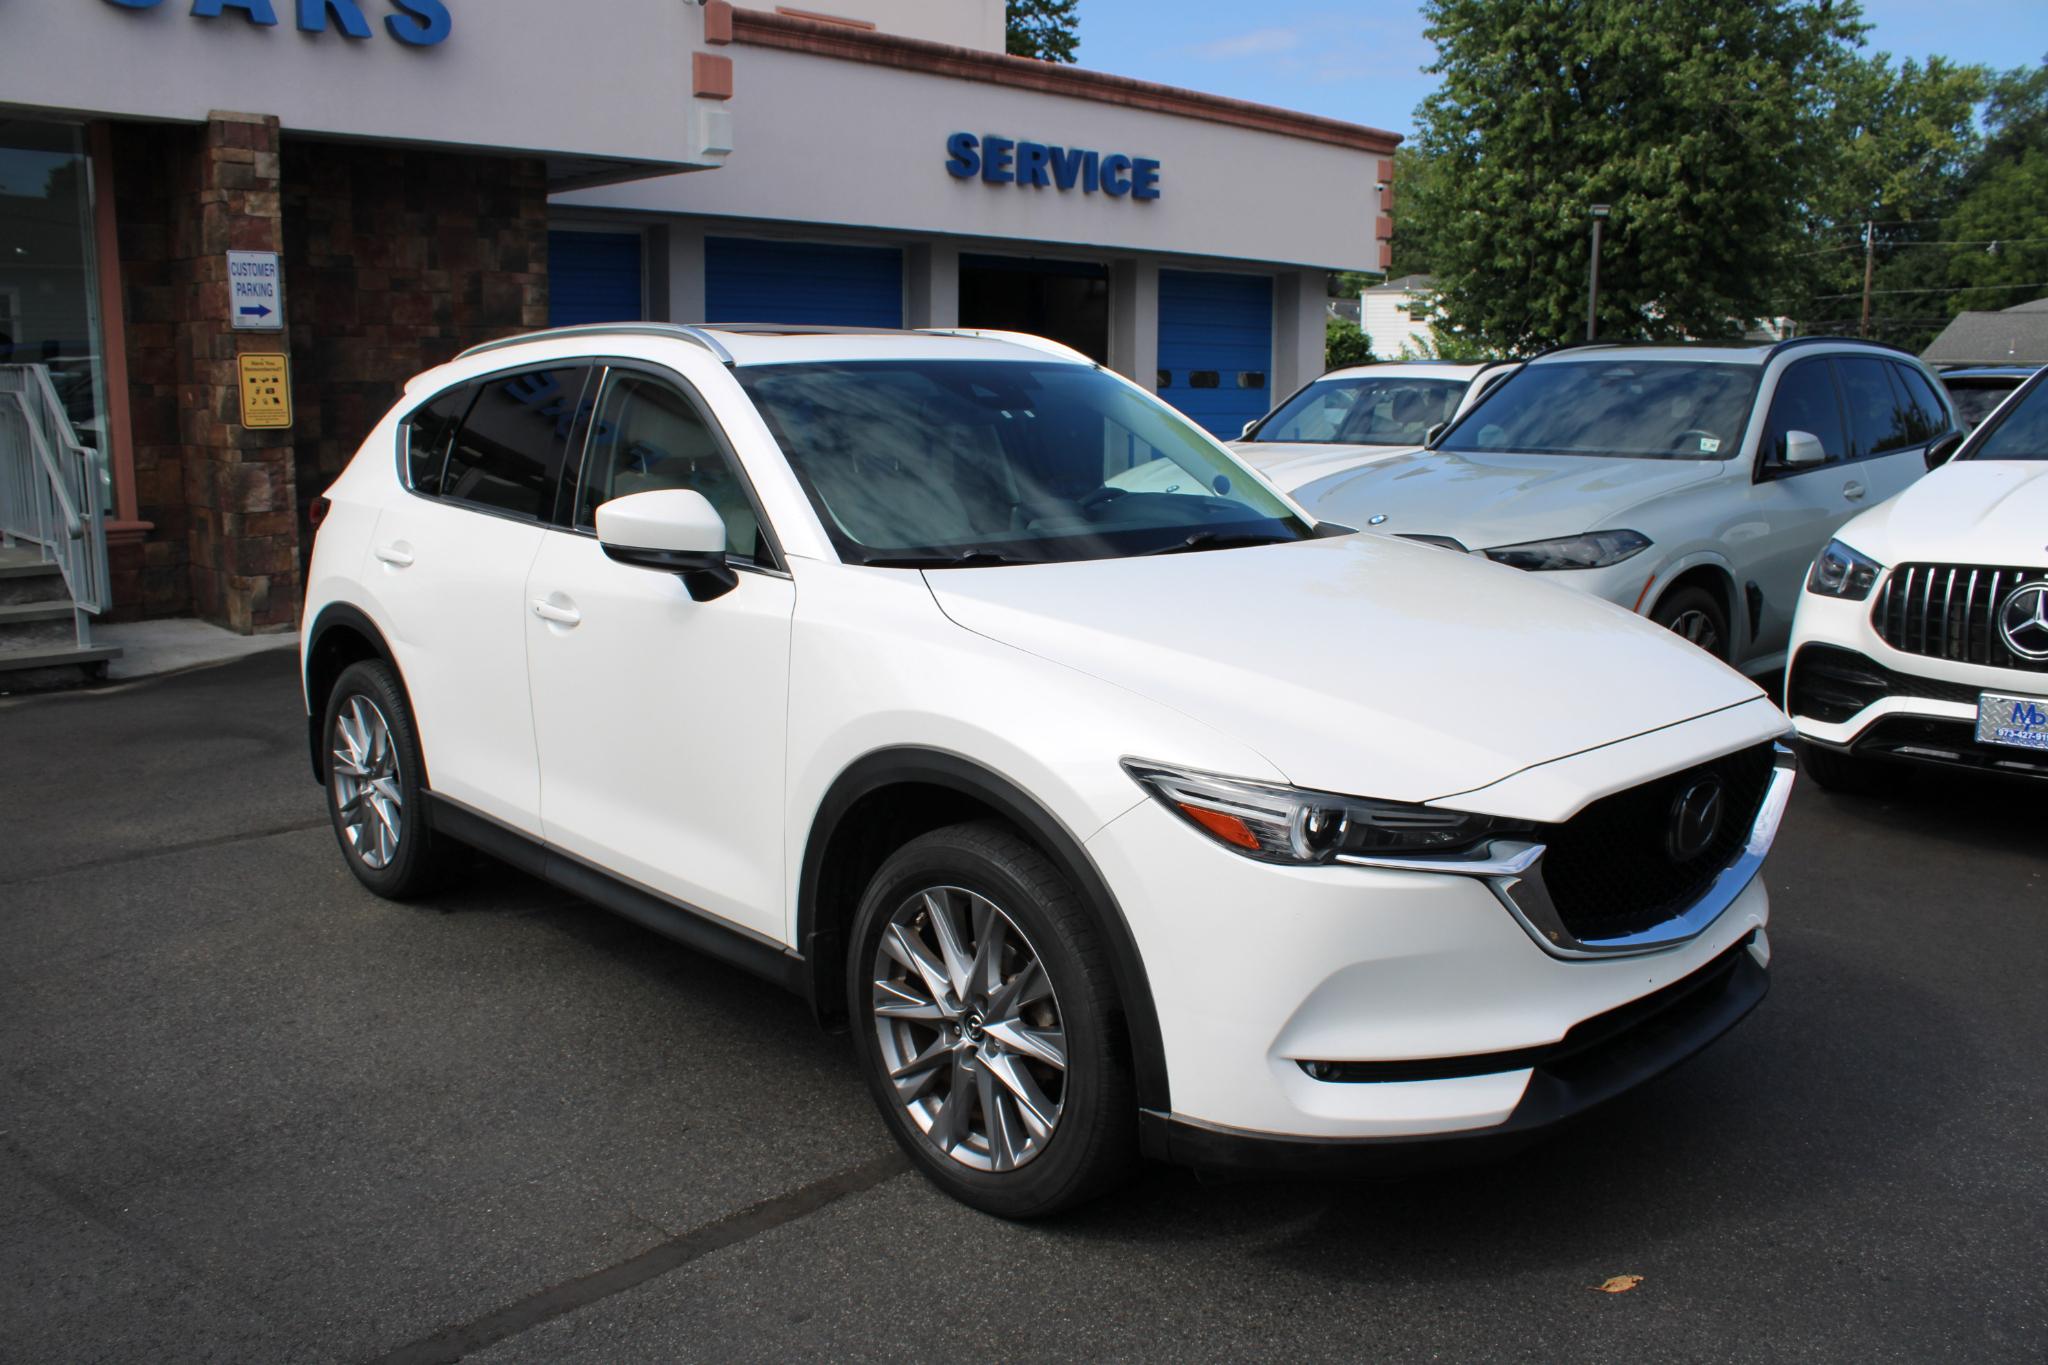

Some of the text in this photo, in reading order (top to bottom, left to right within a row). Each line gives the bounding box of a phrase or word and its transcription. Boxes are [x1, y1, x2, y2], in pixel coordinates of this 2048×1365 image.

[945, 132, 1161, 200] SERVICE
[231, 262, 275, 277] CUSTOMER
[236, 282, 273, 297] PARKING
[1997, 727, 2048, 741] 973-427-91
